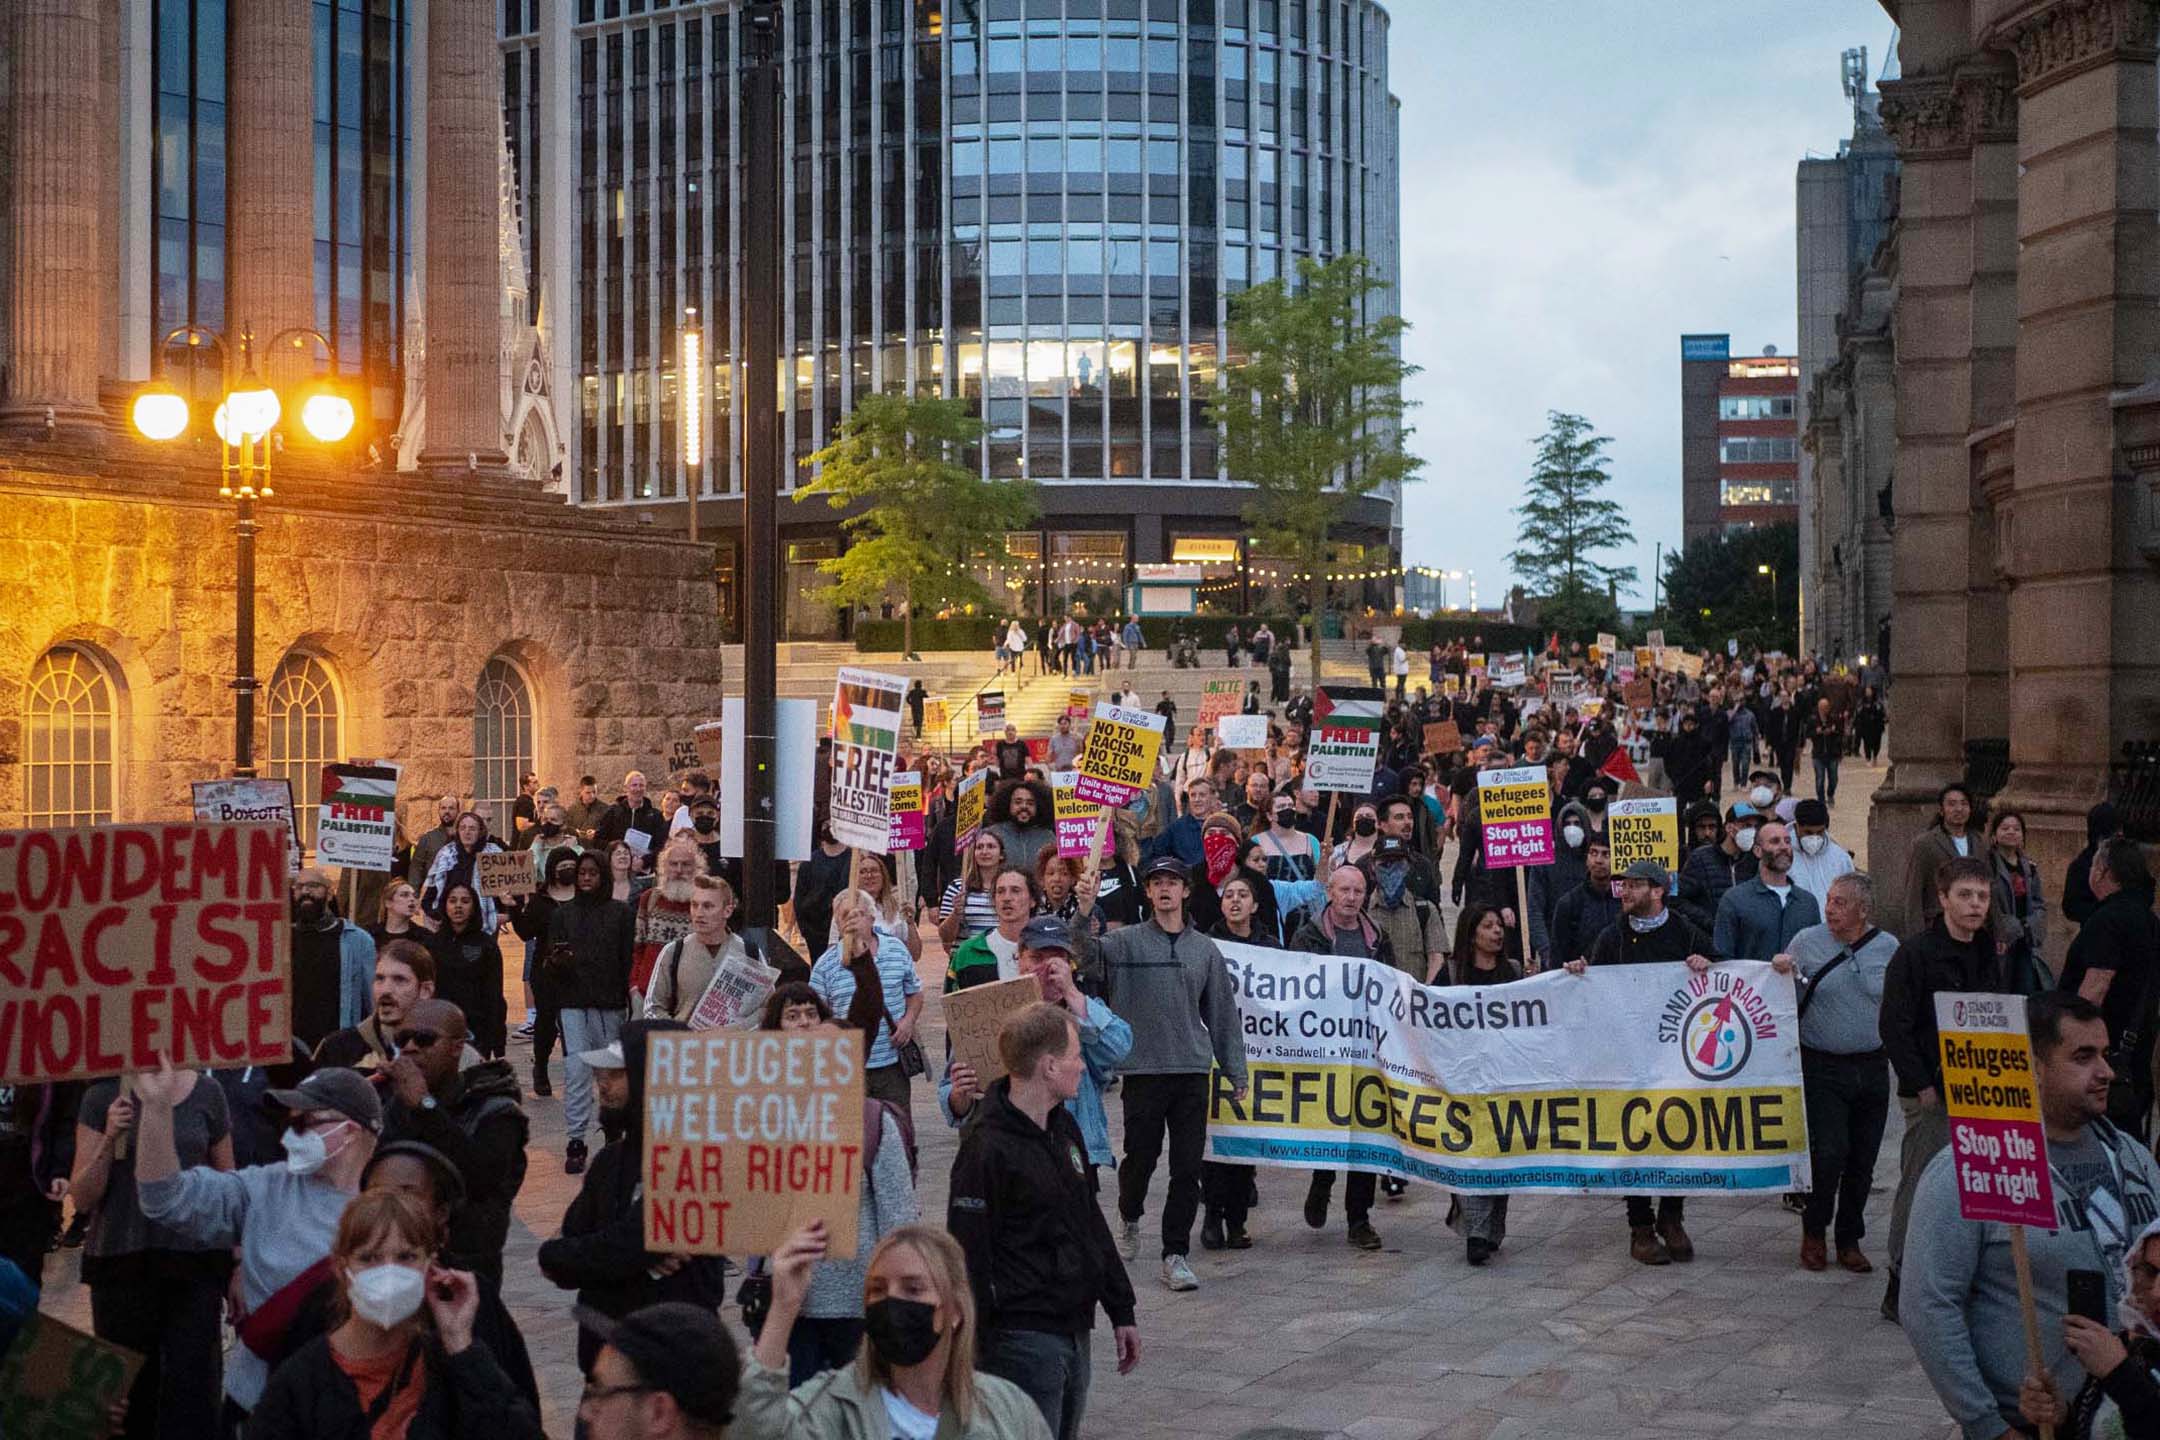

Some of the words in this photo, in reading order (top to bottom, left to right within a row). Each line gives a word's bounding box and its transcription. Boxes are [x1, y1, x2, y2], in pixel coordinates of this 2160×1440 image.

[1094, 721, 1114, 736] NO
[1118, 726, 1135, 741] TO
[1321, 725, 1371, 744] FREE
[674, 741, 697, 755] FUC
[1091, 734, 1145, 759] RACISM.
[1310, 744, 1376, 757] PALESTINE
[1088, 747, 1108, 762] NO
[1112, 752, 1129, 767] TO
[833, 742, 894, 796] FREE
[1084, 760, 1142, 784] FASCISM
[1078, 786, 1091, 797] the
[1092, 789, 1104, 801] far
[1104, 793, 1123, 805] right
[1080, 776, 1101, 790] Unite
[1102, 782, 1130, 797] against
[1483, 788, 1546, 803] Refugees
[832, 785, 888, 817] PALESTINE
[889, 801, 917, 811] come
[1058, 803, 1100, 814] welcom
[1485, 804, 1544, 819] welcome
[321, 819, 391, 836] PALESTINE
[1059, 821, 1085, 836] Stop
[1087, 819, 1098, 832] th
[1486, 826, 1518, 842] Stop
[1521, 823, 1544, 838] the
[1612, 818, 1631, 831] NO
[1634, 818, 1651, 830] TO
[1060, 835, 1075, 848] far
[1613, 830, 1666, 844] RACISM.
[1487, 843, 1508, 857] far
[1511, 839, 1545, 857] right
[1614, 844, 1632, 857] NO
[1635, 844, 1653, 857] TO
[1342, 962, 1383, 1012] Up
[1389, 985, 1405, 1021] to
[1410, 988, 1548, 1030] Racism
[1659, 989, 1692, 1043] STAND
[1688, 974, 1709, 998] UP
[1714, 972, 1730, 992] TO
[1732, 977, 1777, 1040] RACISM
[1238, 1007, 1290, 1037] lack
[1299, 1010, 1387, 1050] Country
[1275, 1045, 1326, 1059] Sandwell
[1945, 1038, 2029, 1077] Refugees
[652, 1038, 854, 1087] REFUGEES
[1949, 1075, 2033, 1109] welcome
[650, 1093, 839, 1142] WELCOME
[1211, 1068, 1472, 1153] REFUGEES
[1488, 1095, 1788, 1152] WELCOME
[1956, 1124, 2000, 1165] Stop
[2004, 1129, 2036, 1161] the
[652, 1144, 723, 1193] FAR
[748, 1144, 859, 1195] RIGHT
[1620, 1170, 1728, 1188] @AntiRacismDay
[1961, 1162, 1991, 1193] far
[1995, 1166, 2040, 1205] right
[653, 1198, 732, 1248] NOT
